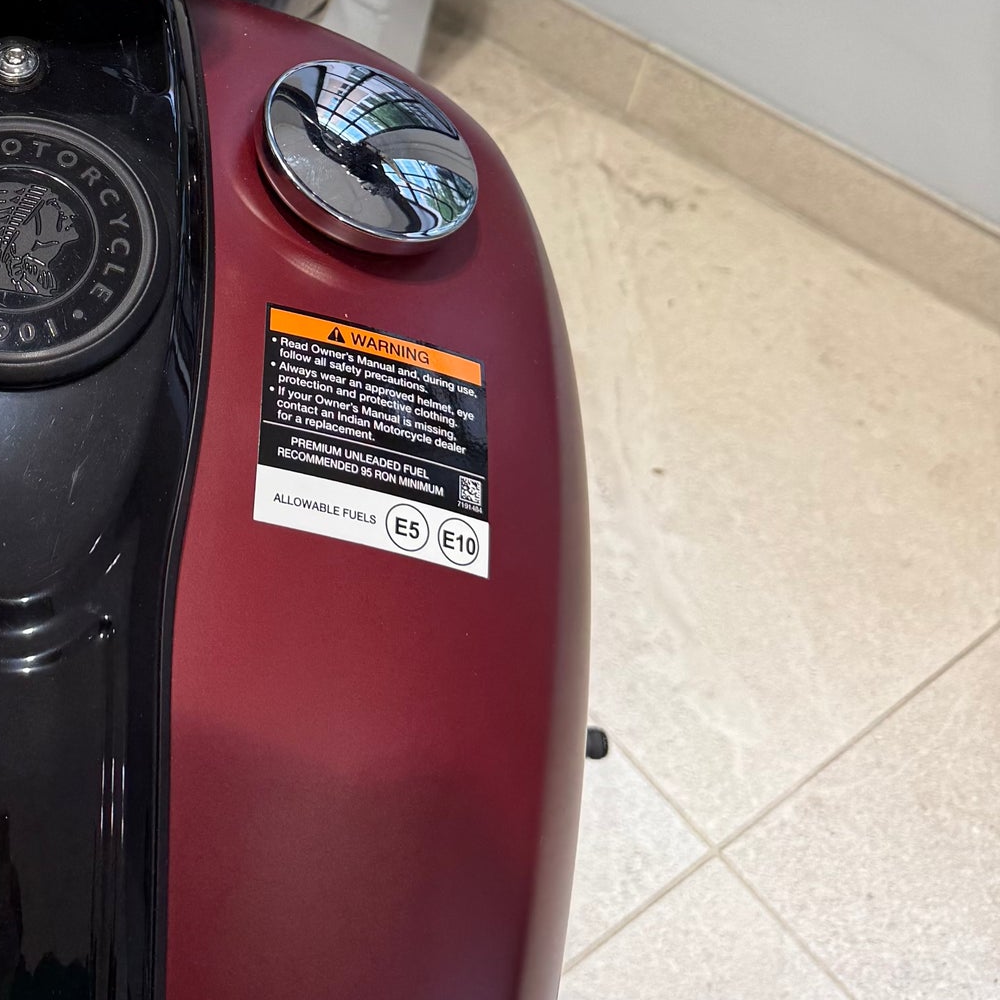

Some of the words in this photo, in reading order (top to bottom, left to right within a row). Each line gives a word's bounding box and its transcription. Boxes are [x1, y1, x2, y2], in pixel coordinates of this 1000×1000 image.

[279, 348, 312, 363] follow
[314, 357, 327, 366] all
[329, 360, 361, 377] safety
[364, 370, 428, 394] precautions.
[280, 336, 309, 351] Read
[311, 344, 354, 362] Owner's
[356, 354, 395, 373] Manual
[397, 367, 420, 381] and,
[422, 373, 455, 392] during
[350, 332, 430, 364] WARNING
[278, 374, 333, 393] protection
[336, 387, 356, 399] and
[359, 393, 412, 413] protective
[414, 407, 458, 428] clothing.
[278, 386, 286, 396] If
[287, 389, 312, 402] your
[315, 394, 359, 413] Owner's
[361, 405, 400, 424] Manual
[402, 416, 412, 427] is
[414, 421, 457, 441] missing,
[279, 361, 318, 378] Always
[320, 372, 347, 384] wear
[349, 379, 362, 388] an
[365, 384, 415, 402] approved
[417, 395, 454, 415] helmet,
[456, 408, 475, 421] eye
[277, 409, 292, 421] for
[295, 415, 302, 424] a
[305, 418, 375, 441] replacement.
[277, 399, 318, 415] contact
[321, 410, 334, 419] an
[337, 411, 371, 428] Indian
[373, 420, 432, 444] Motorcycle
[434, 438, 467, 454] dealer
[277, 446, 359, 474] RECOMMENDED
[360, 466, 373, 477] 95
[374, 469, 397, 483] RON
[398, 476, 444, 497] MINIMUM
[290, 436, 342, 457] PREMIUM
[344, 448, 401, 471] UNLEADED
[403, 464, 430, 480] FUEL
[273, 492, 340, 516] ALLOWABLE
[342, 508, 377, 524] FUELS
[394, 516, 420, 539] E5
[442, 529, 476, 556] E10
